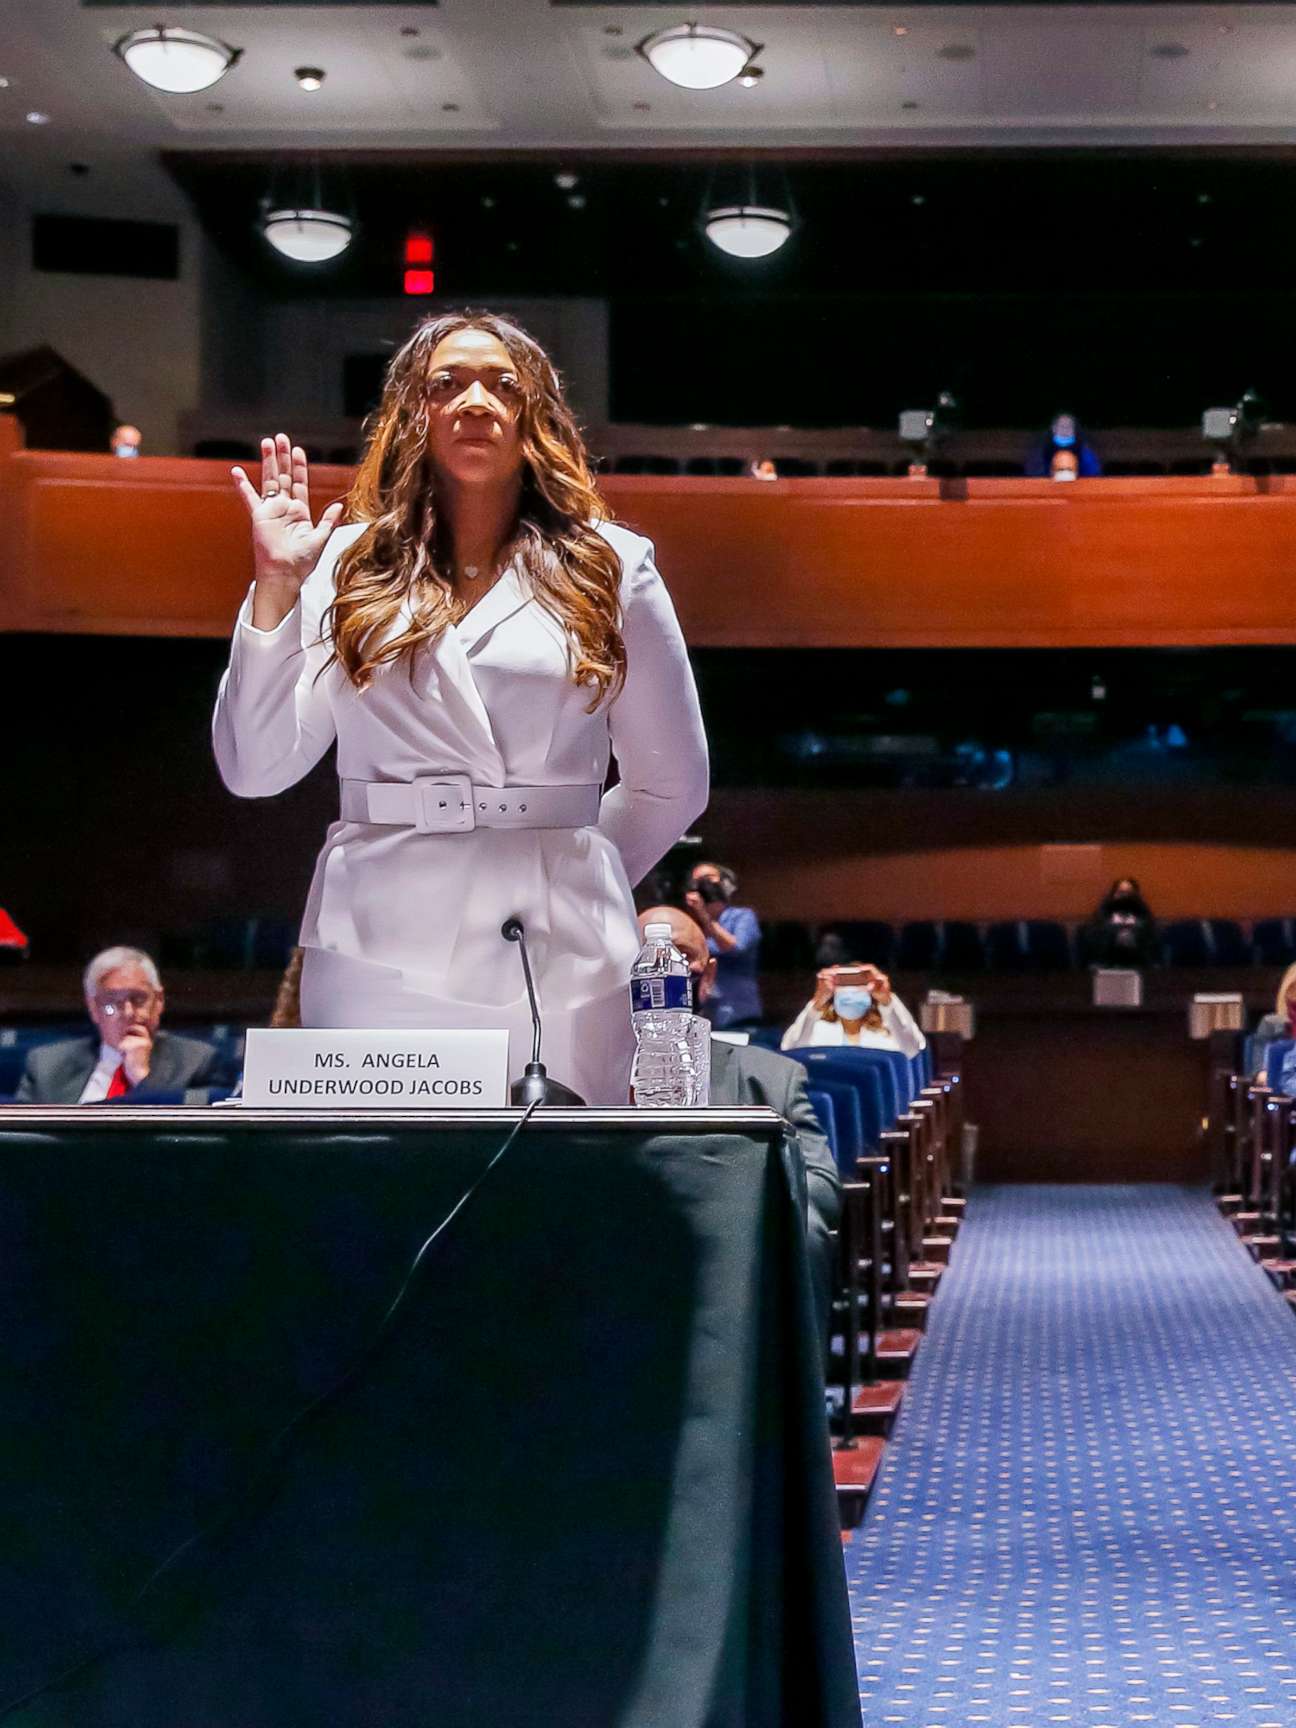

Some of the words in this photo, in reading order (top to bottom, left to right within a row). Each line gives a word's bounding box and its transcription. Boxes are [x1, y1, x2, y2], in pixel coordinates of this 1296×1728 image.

[314, 1053, 350, 1068] MS.
[361, 1053, 440, 1068] ANGELA
[269, 1079, 404, 1095] UNDERWOOD
[409, 1080, 482, 1095] JACOBS
